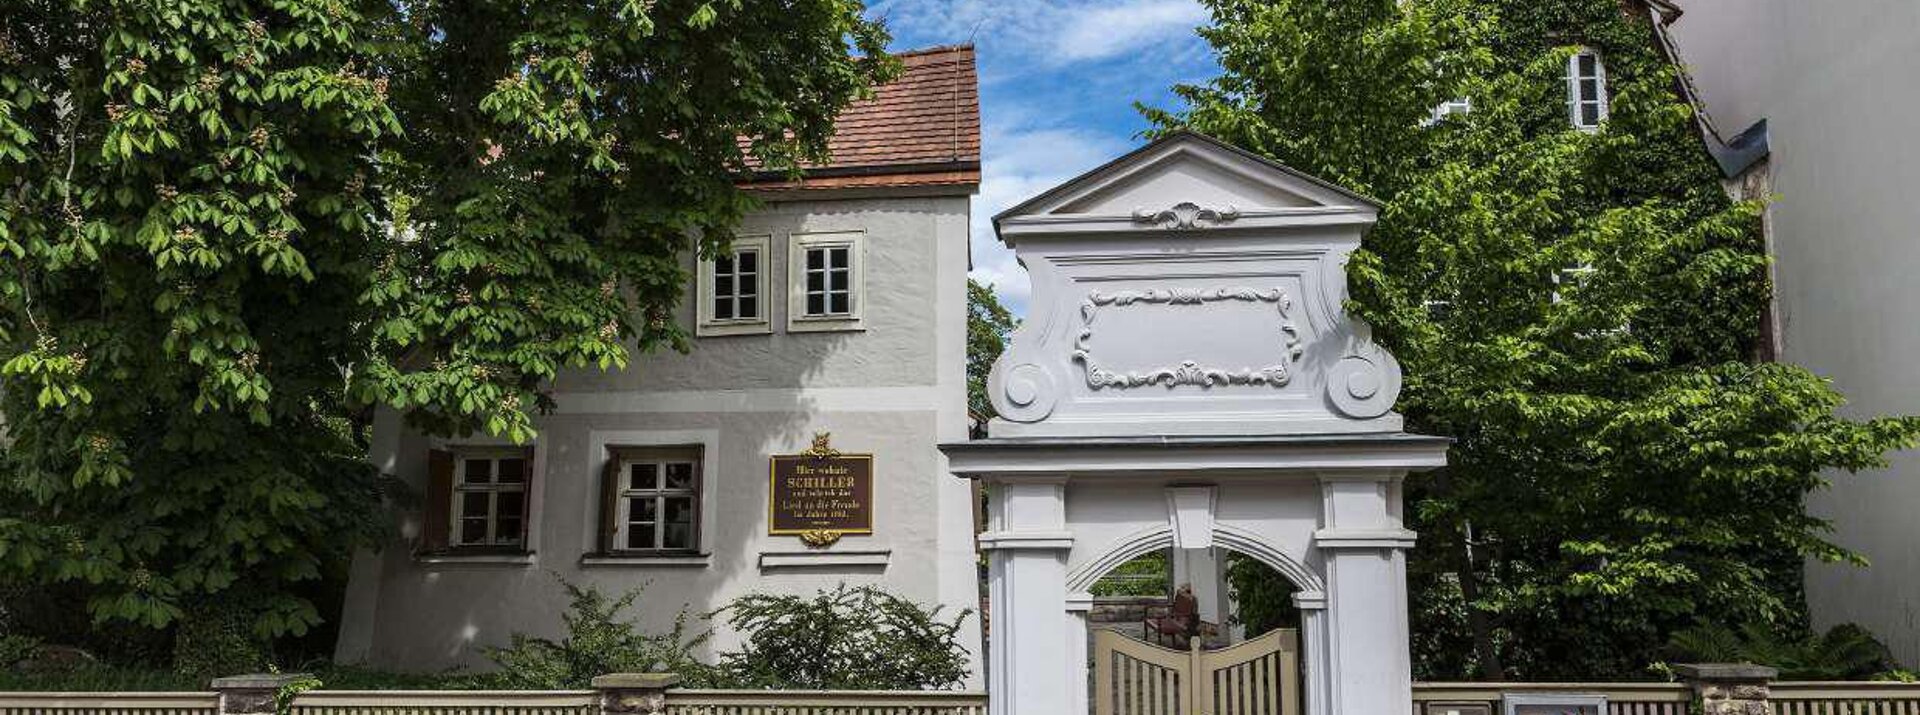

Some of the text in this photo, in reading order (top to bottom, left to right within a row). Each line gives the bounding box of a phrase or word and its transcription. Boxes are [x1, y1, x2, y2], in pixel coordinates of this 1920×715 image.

[796, 465, 815, 474] Hier
[787, 477, 854, 488] SCHILLER
[840, 488, 851, 496] das
